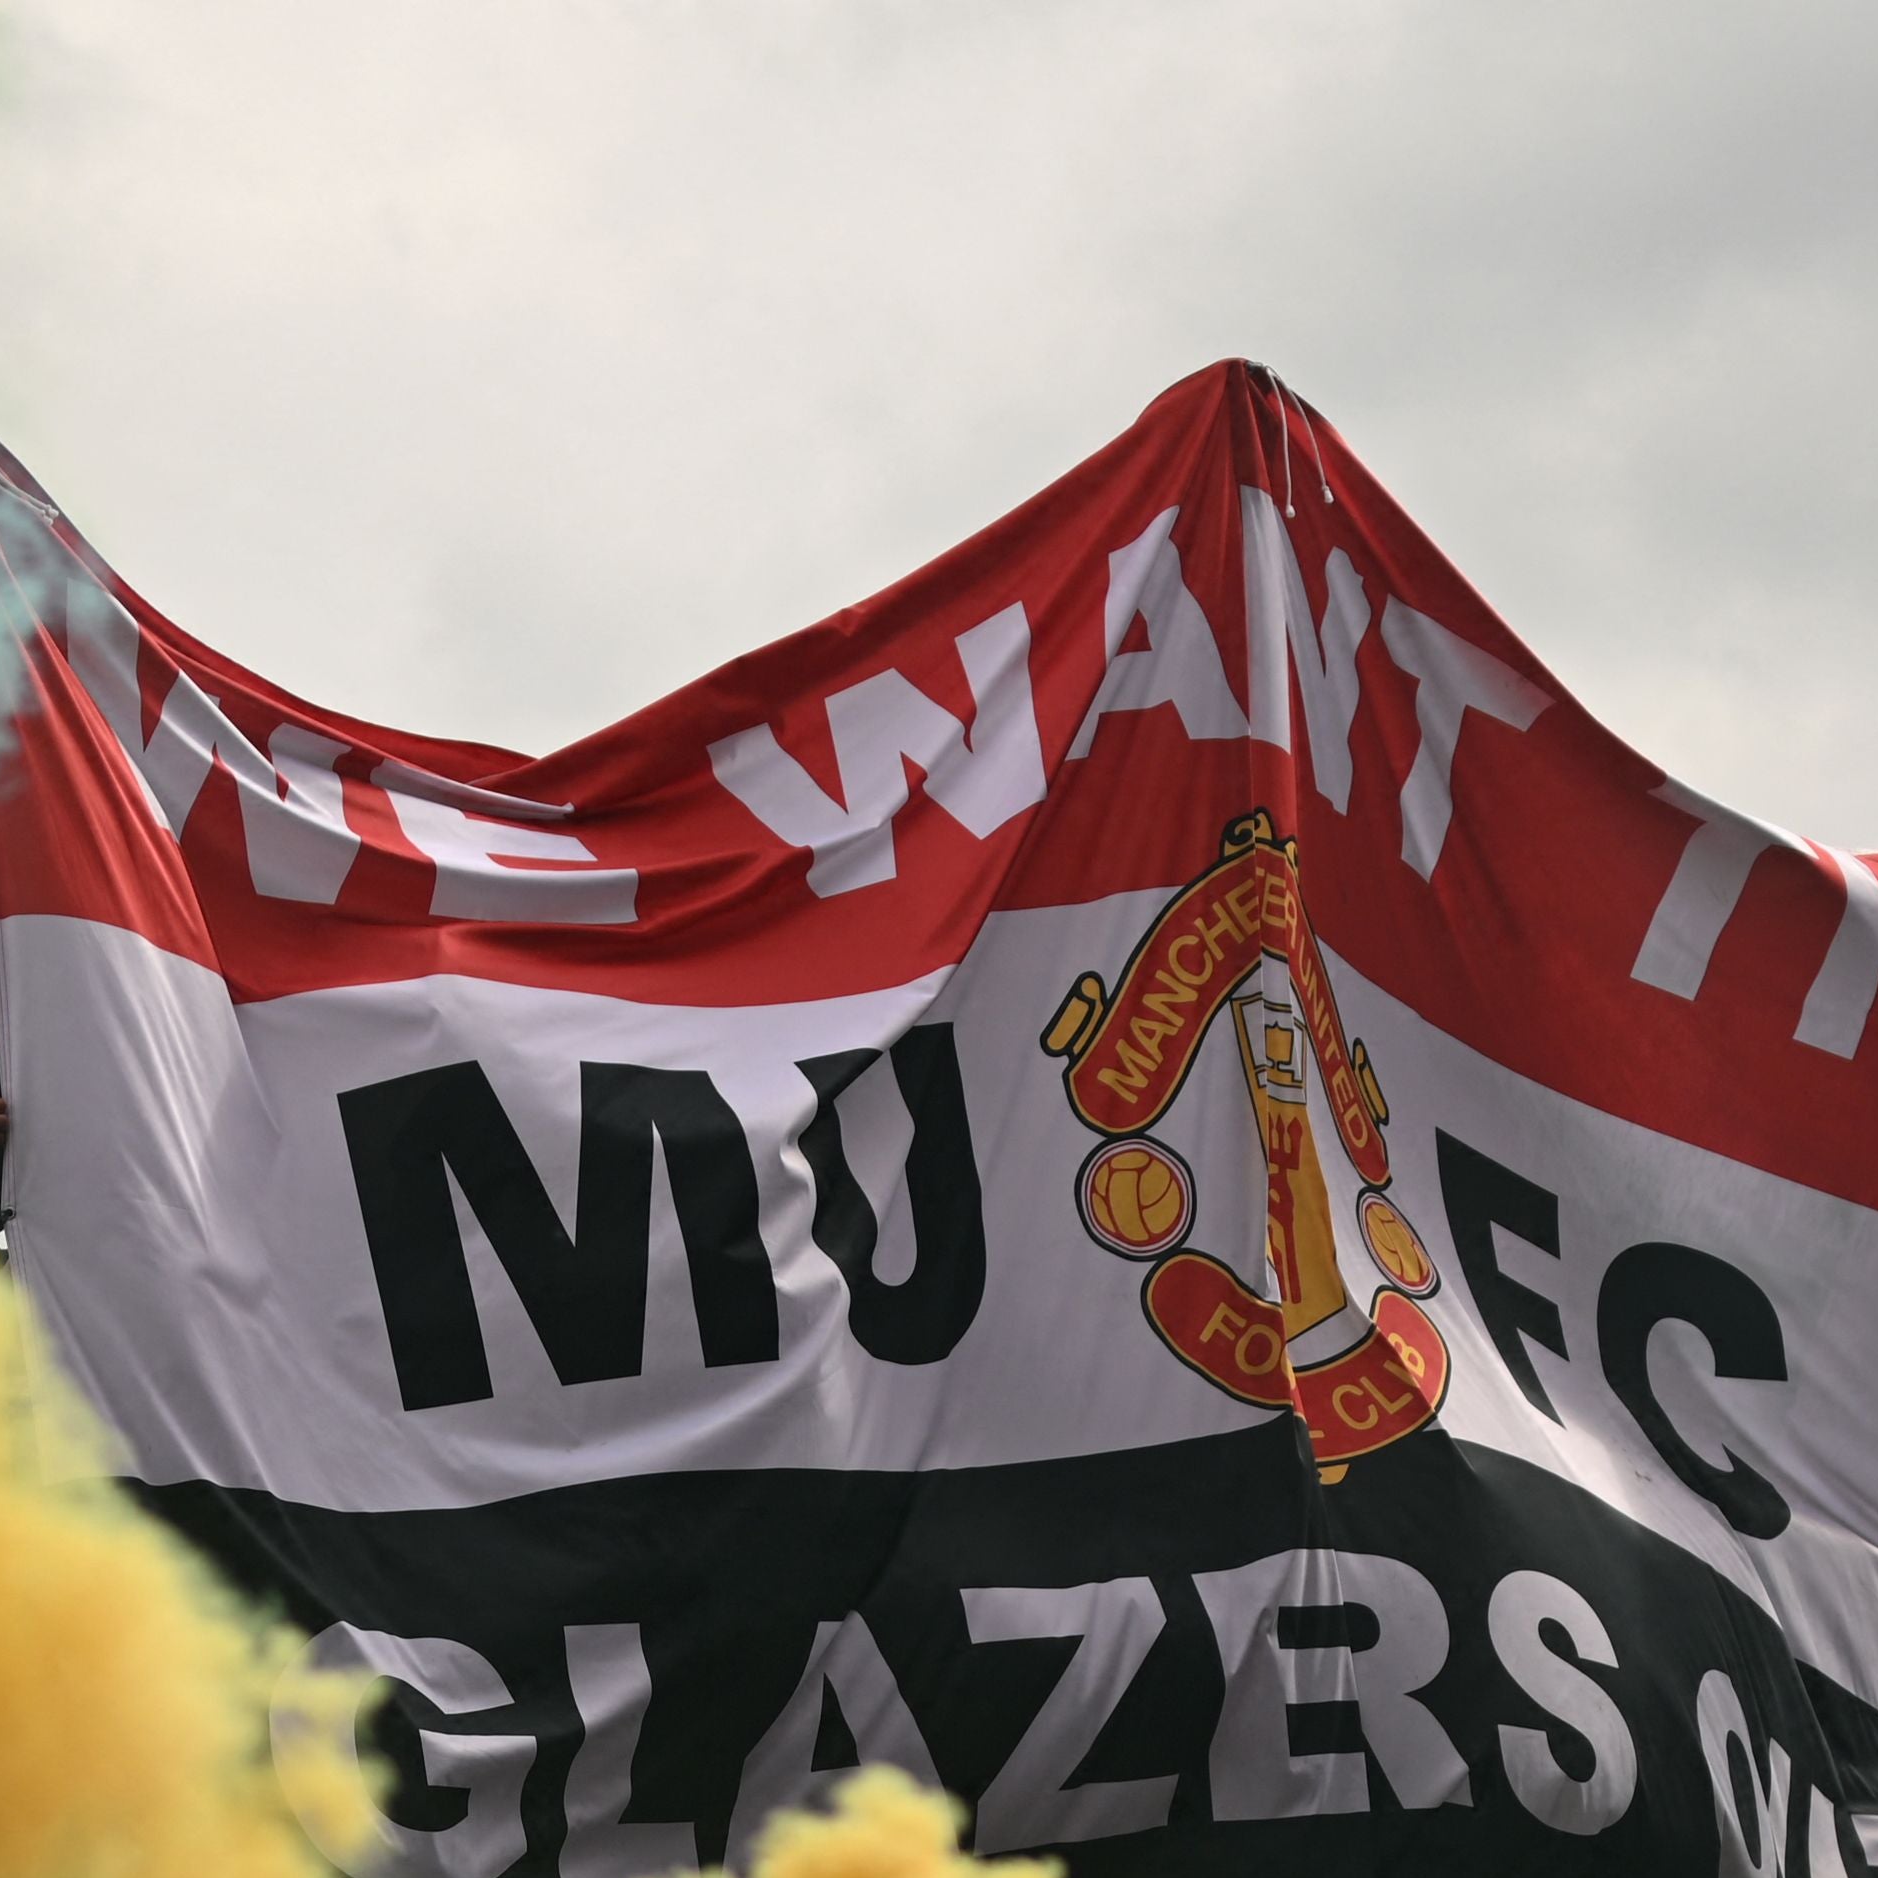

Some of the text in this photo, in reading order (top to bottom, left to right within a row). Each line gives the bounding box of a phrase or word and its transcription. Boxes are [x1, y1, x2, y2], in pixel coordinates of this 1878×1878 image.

[66, 576, 639, 924] WE
[706, 484, 1557, 899] WANT
[1297, 932, 1370, 1149] UNITED
[336, 1022, 1792, 1540] MU FC
